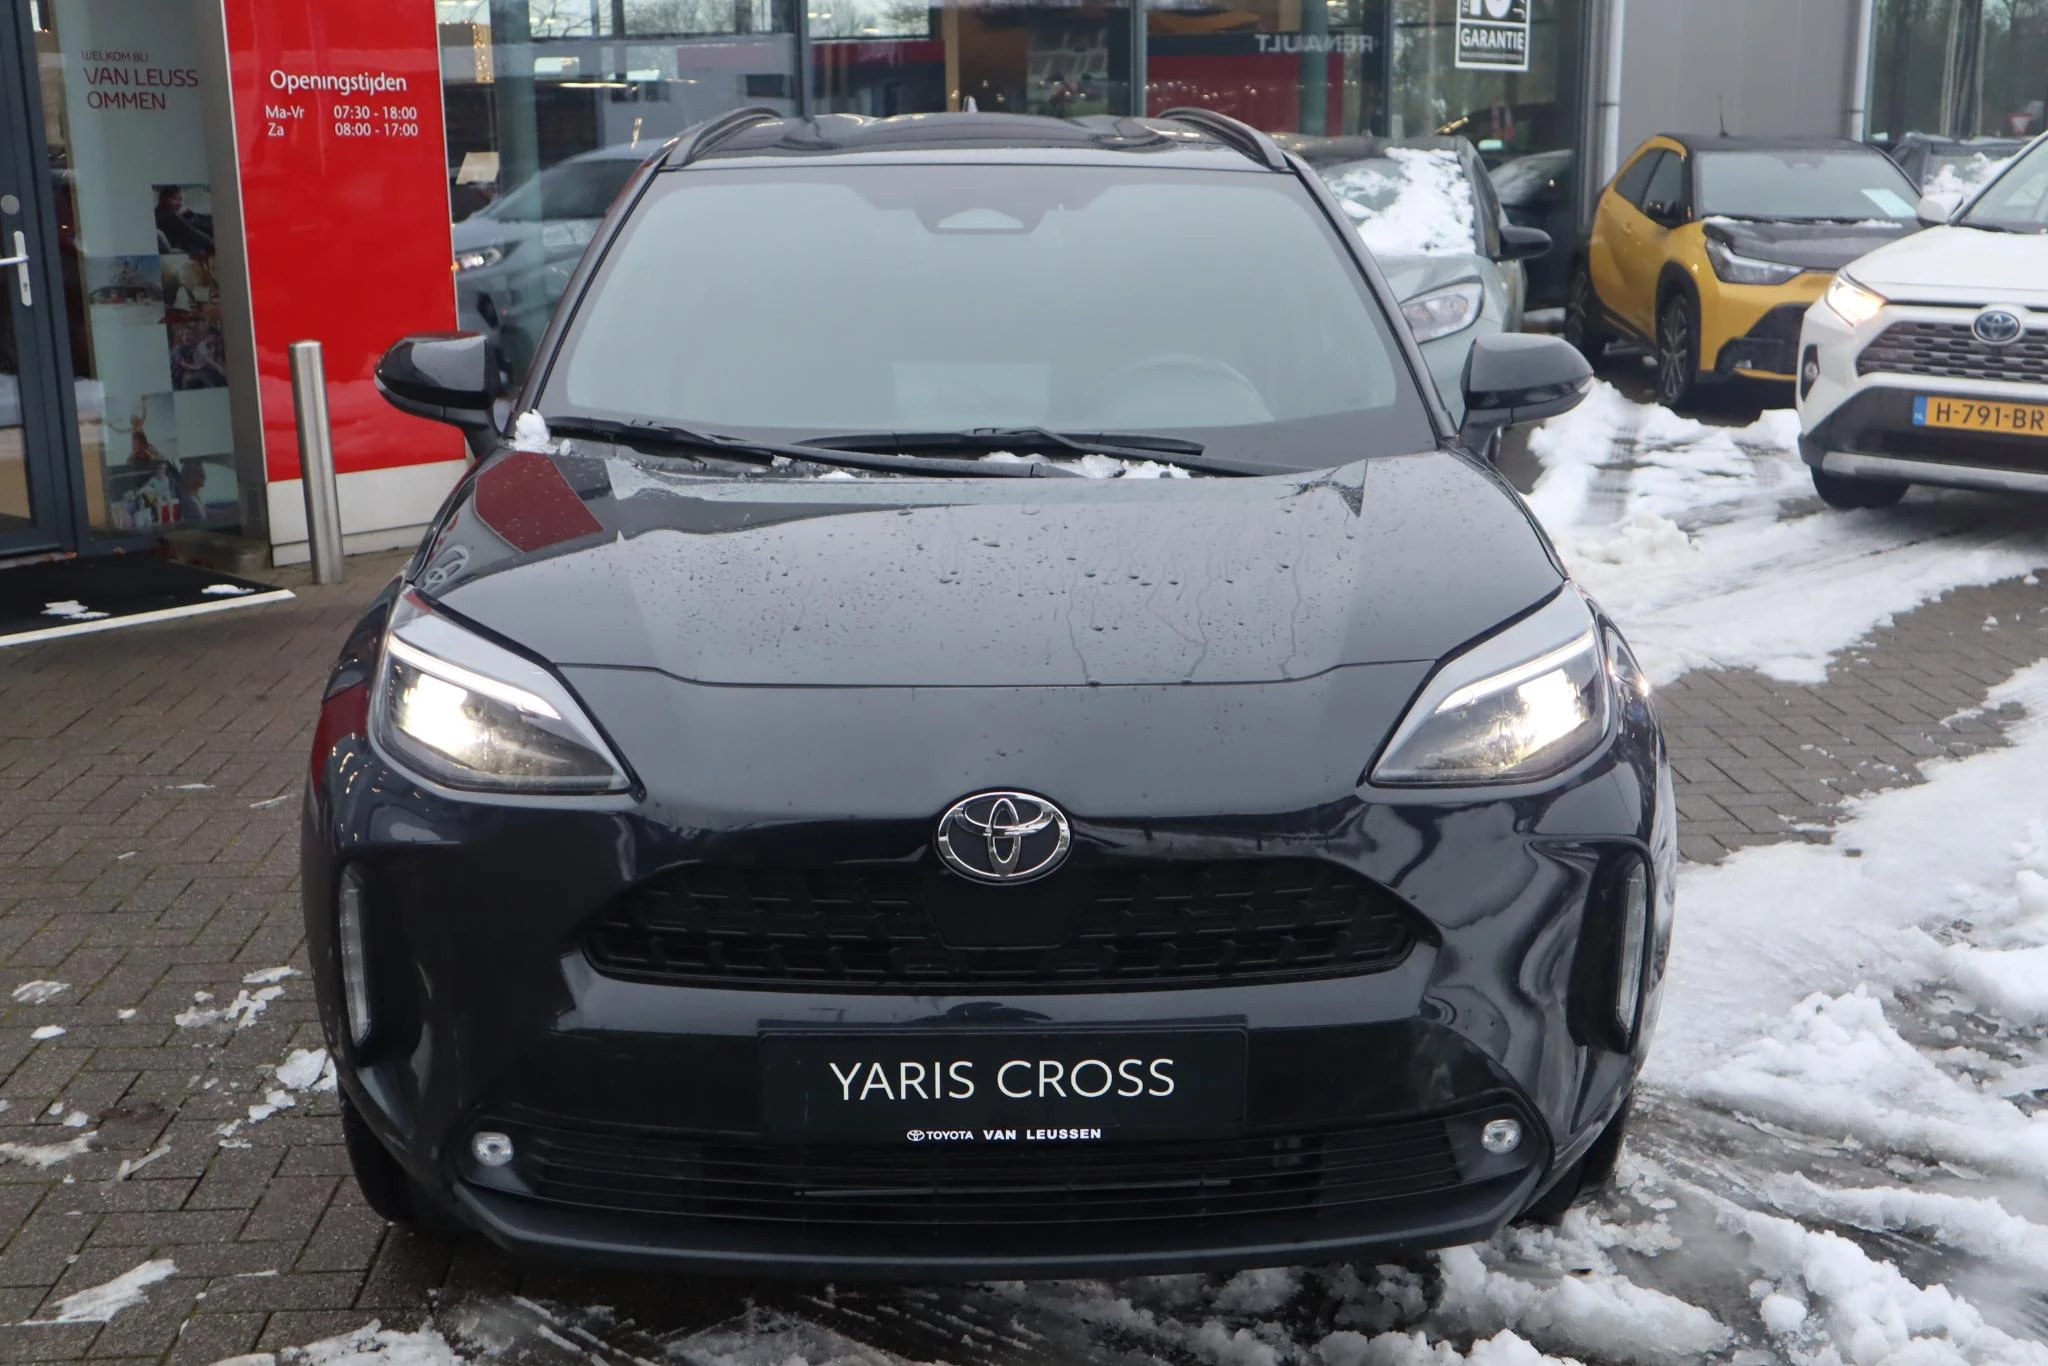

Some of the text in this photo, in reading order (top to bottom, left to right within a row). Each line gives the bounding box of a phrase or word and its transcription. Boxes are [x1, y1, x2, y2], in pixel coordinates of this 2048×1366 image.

[1461, 28, 1525, 50] GARANTIE
[81, 50, 131, 61] WELKOM
[83, 66, 199, 87] VAN LEUSS
[269, 69, 407, 96] Openingstijden
[87, 90, 167, 110] OMMEN
[265, 105, 304, 119] Ma-Vr
[333, 105, 370, 119] 07:30
[382, 106, 417, 120] 18:00
[267, 122, 285, 137] Za
[335, 122, 371, 137] 08:00
[384, 123, 418, 137] 17:00
[1936, 402, 2045, 431] H-791-BR
[829, 1058, 1175, 1101] YARIS CROSS
[926, 1128, 1101, 1140] TOYOTA VAN LEUSSEN
